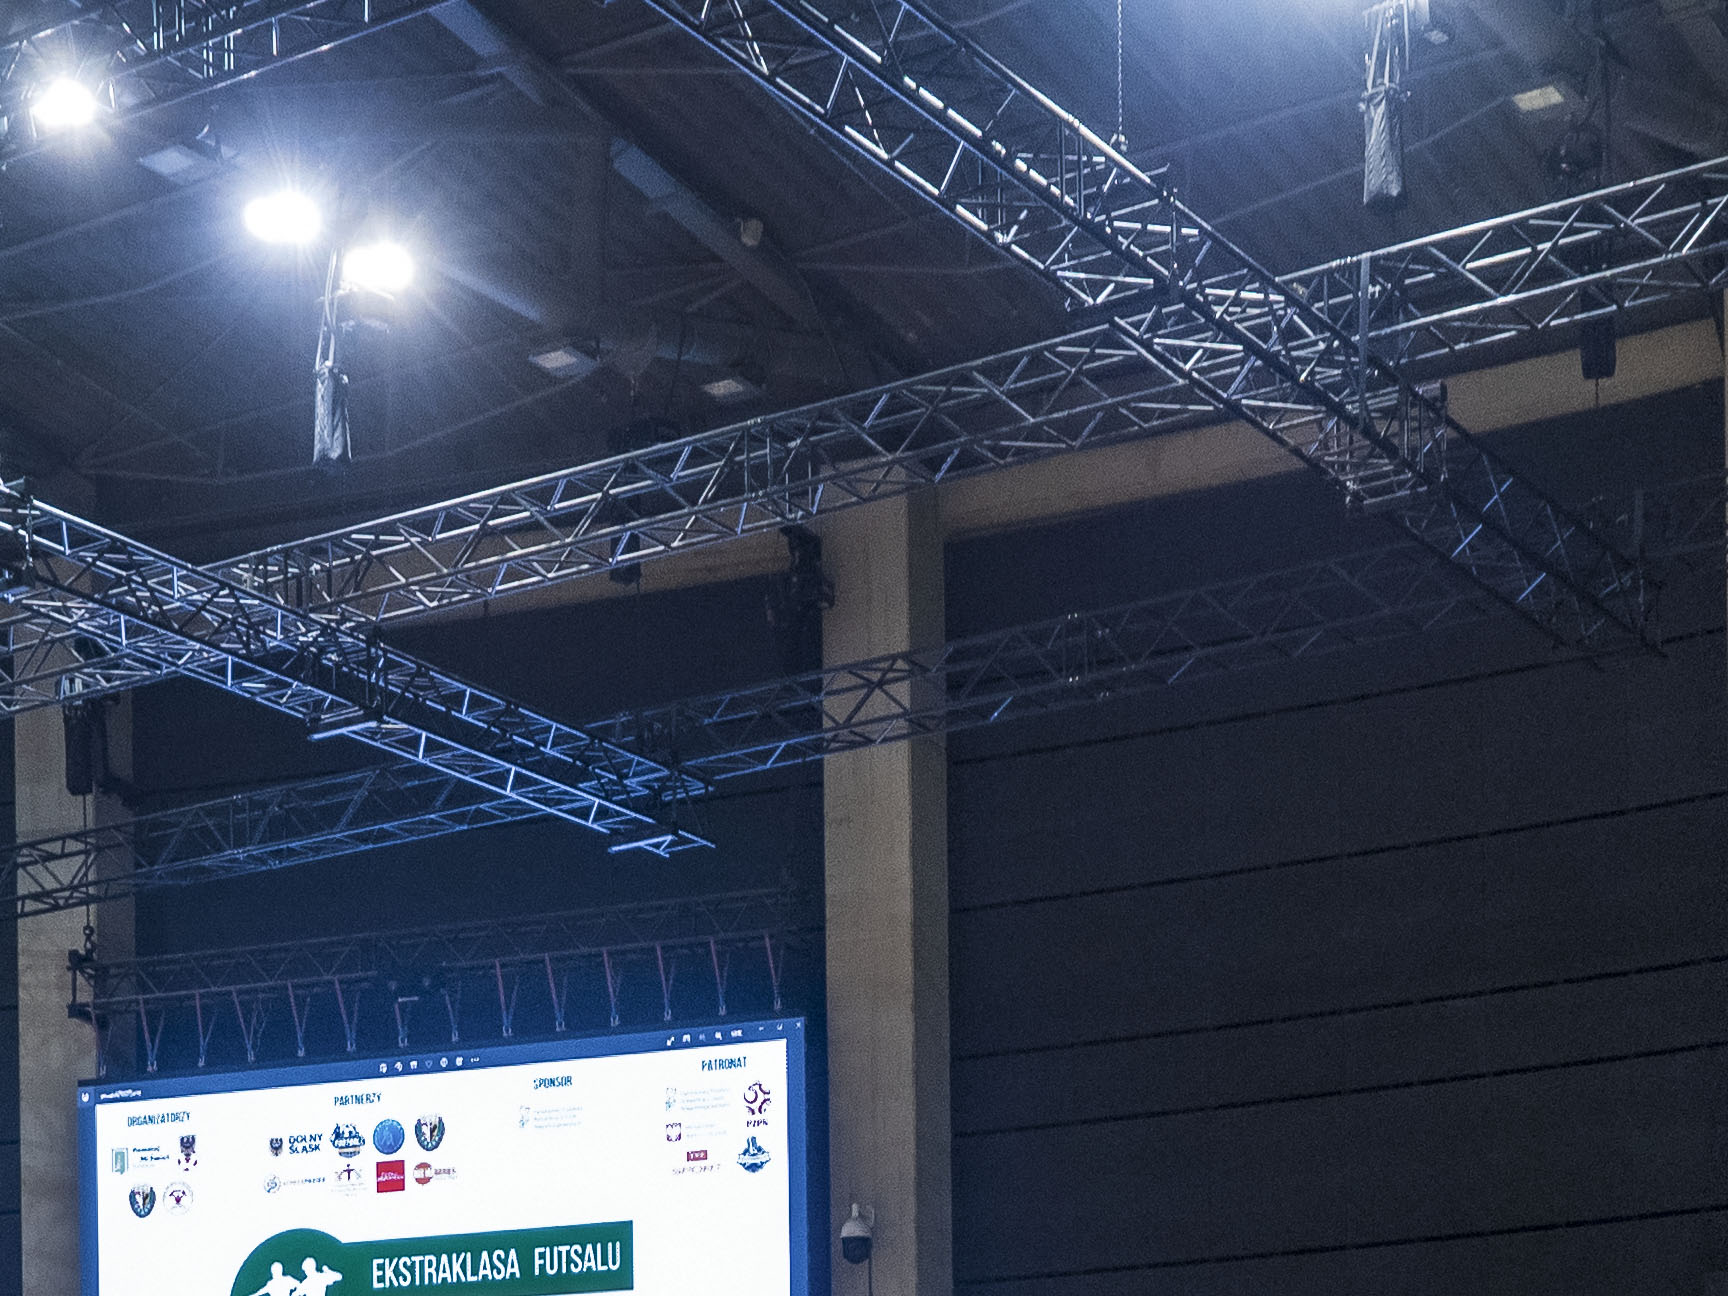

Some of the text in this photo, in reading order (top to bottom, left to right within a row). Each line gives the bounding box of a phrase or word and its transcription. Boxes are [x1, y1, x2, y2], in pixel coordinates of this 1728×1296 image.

[701, 1056, 747, 1071] PATRONAT
[533, 1075, 573, 1090] SPONSOR
[372, 1241, 621, 1289] EKSTRAKLASA FUTSALU
